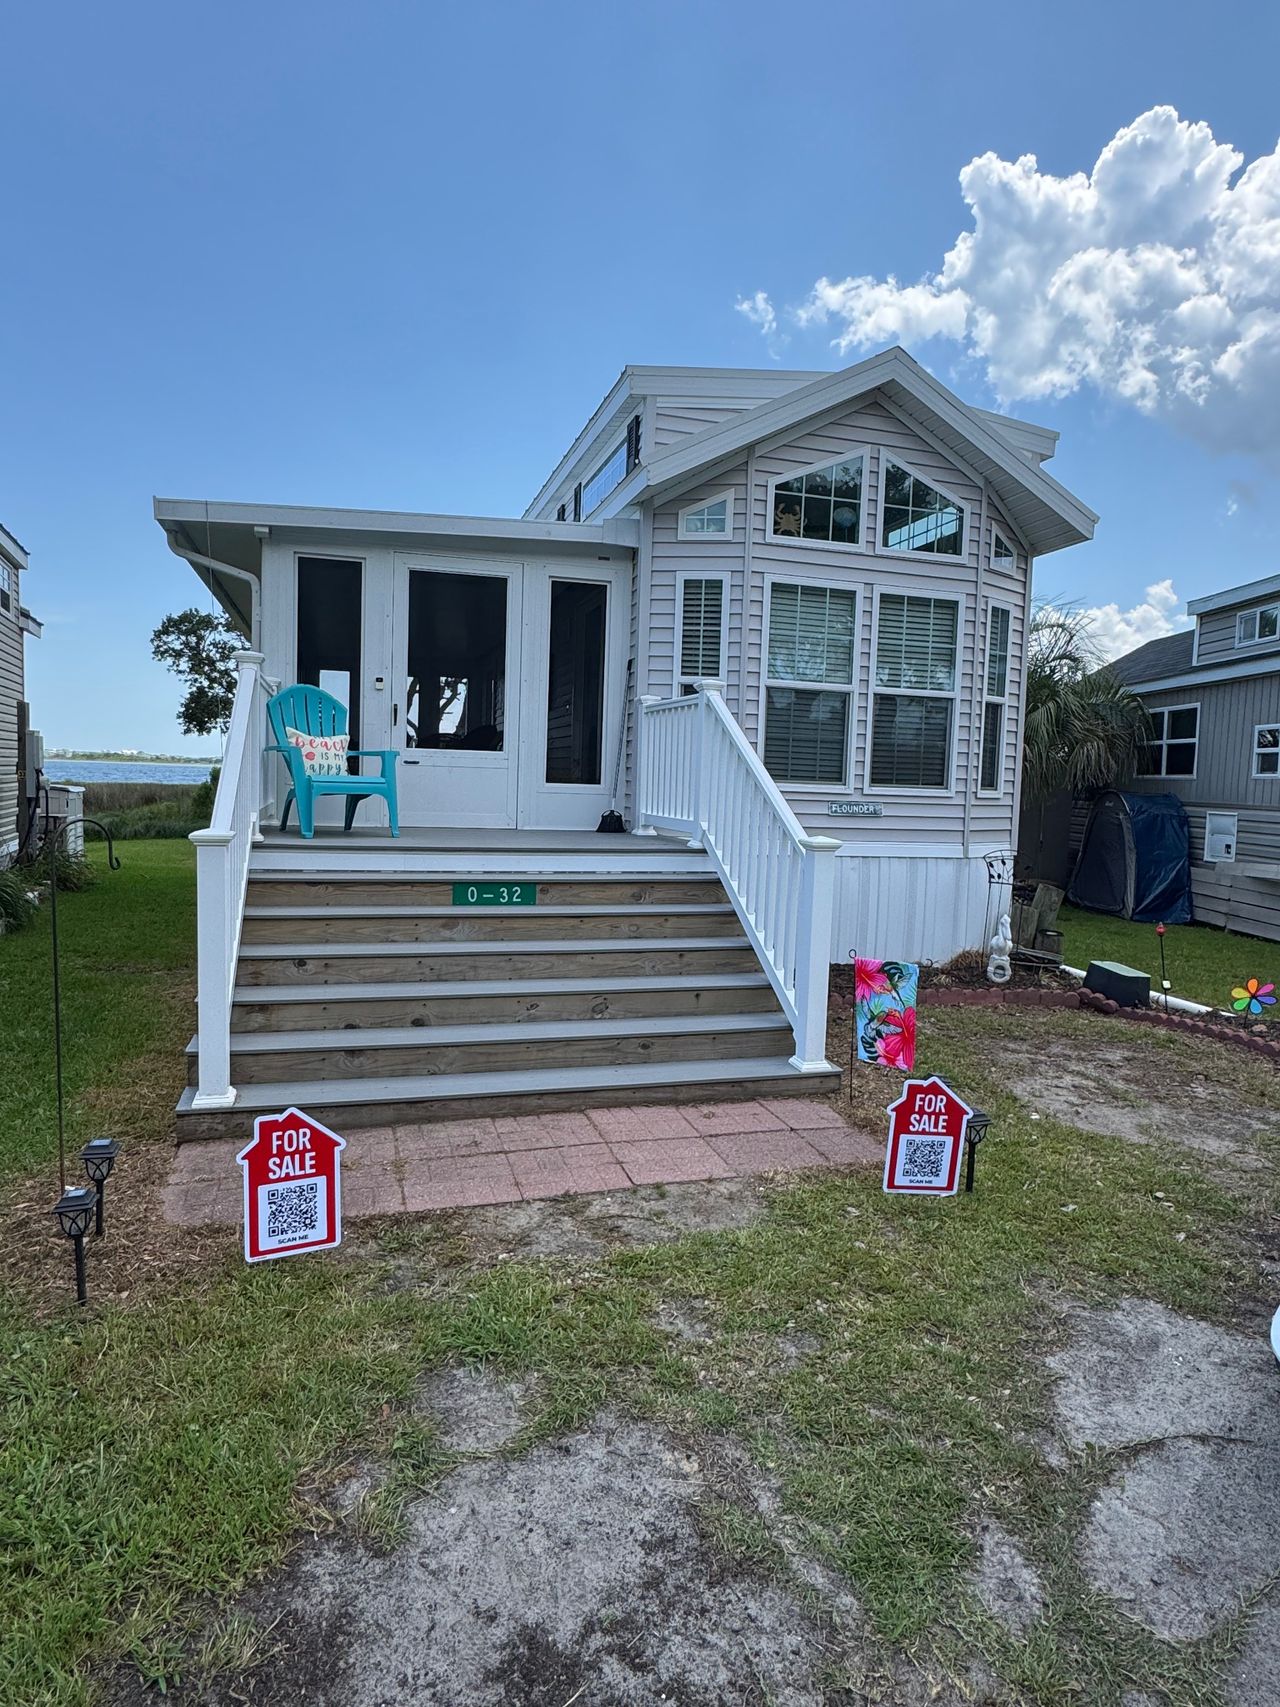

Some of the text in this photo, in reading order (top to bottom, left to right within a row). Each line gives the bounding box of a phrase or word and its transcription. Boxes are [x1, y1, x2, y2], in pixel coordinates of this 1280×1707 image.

[321, 752, 329, 761] IS
[304, 763, 341, 776] appy
[832, 804, 874, 814] FLOUNDER
[915, 1094, 946, 1113] FOR
[909, 1114, 948, 1133] SALE
[272, 1128, 311, 1154] FOR
[268, 1152, 316, 1179] SALE
[278, 1236, 297, 1245] SCAN
